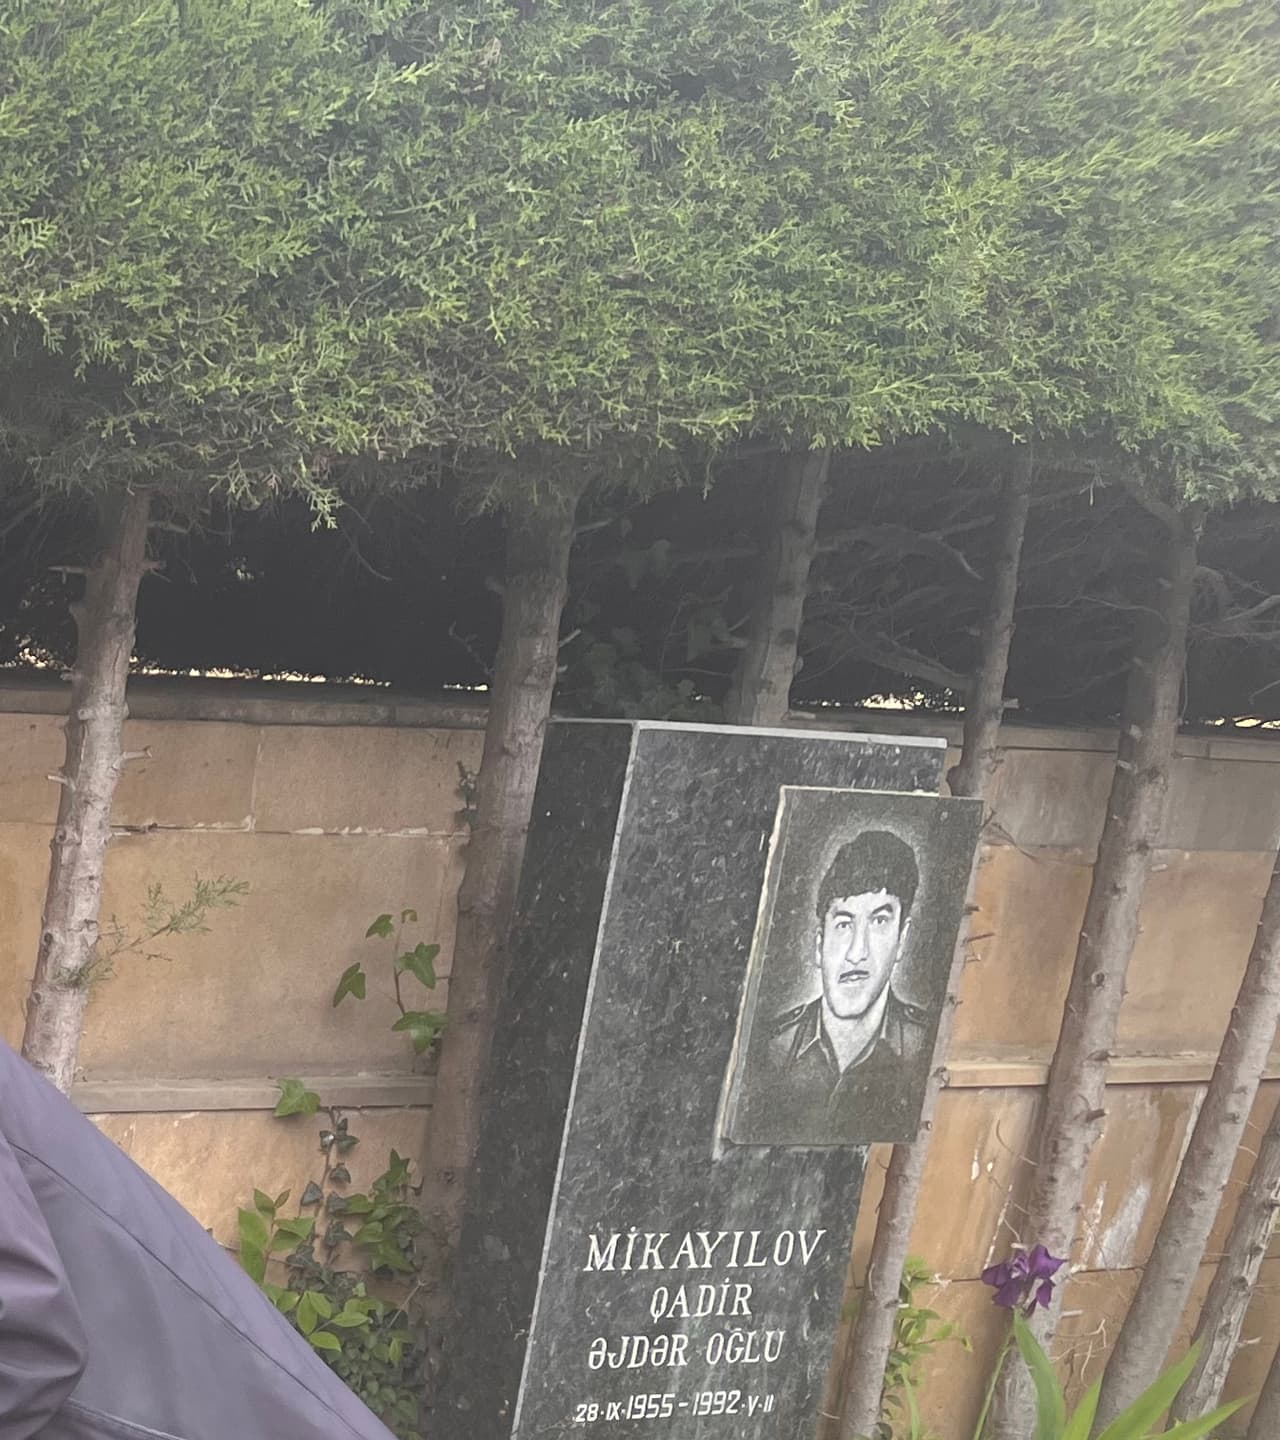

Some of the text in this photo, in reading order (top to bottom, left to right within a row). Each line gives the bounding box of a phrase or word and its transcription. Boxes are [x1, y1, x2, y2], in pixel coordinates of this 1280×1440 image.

[583, 1226, 827, 1271] MİKAYILOV
[650, 1277, 754, 1324] QADİR
[588, 1327, 786, 1370] ƏJDƏR OĞLU
